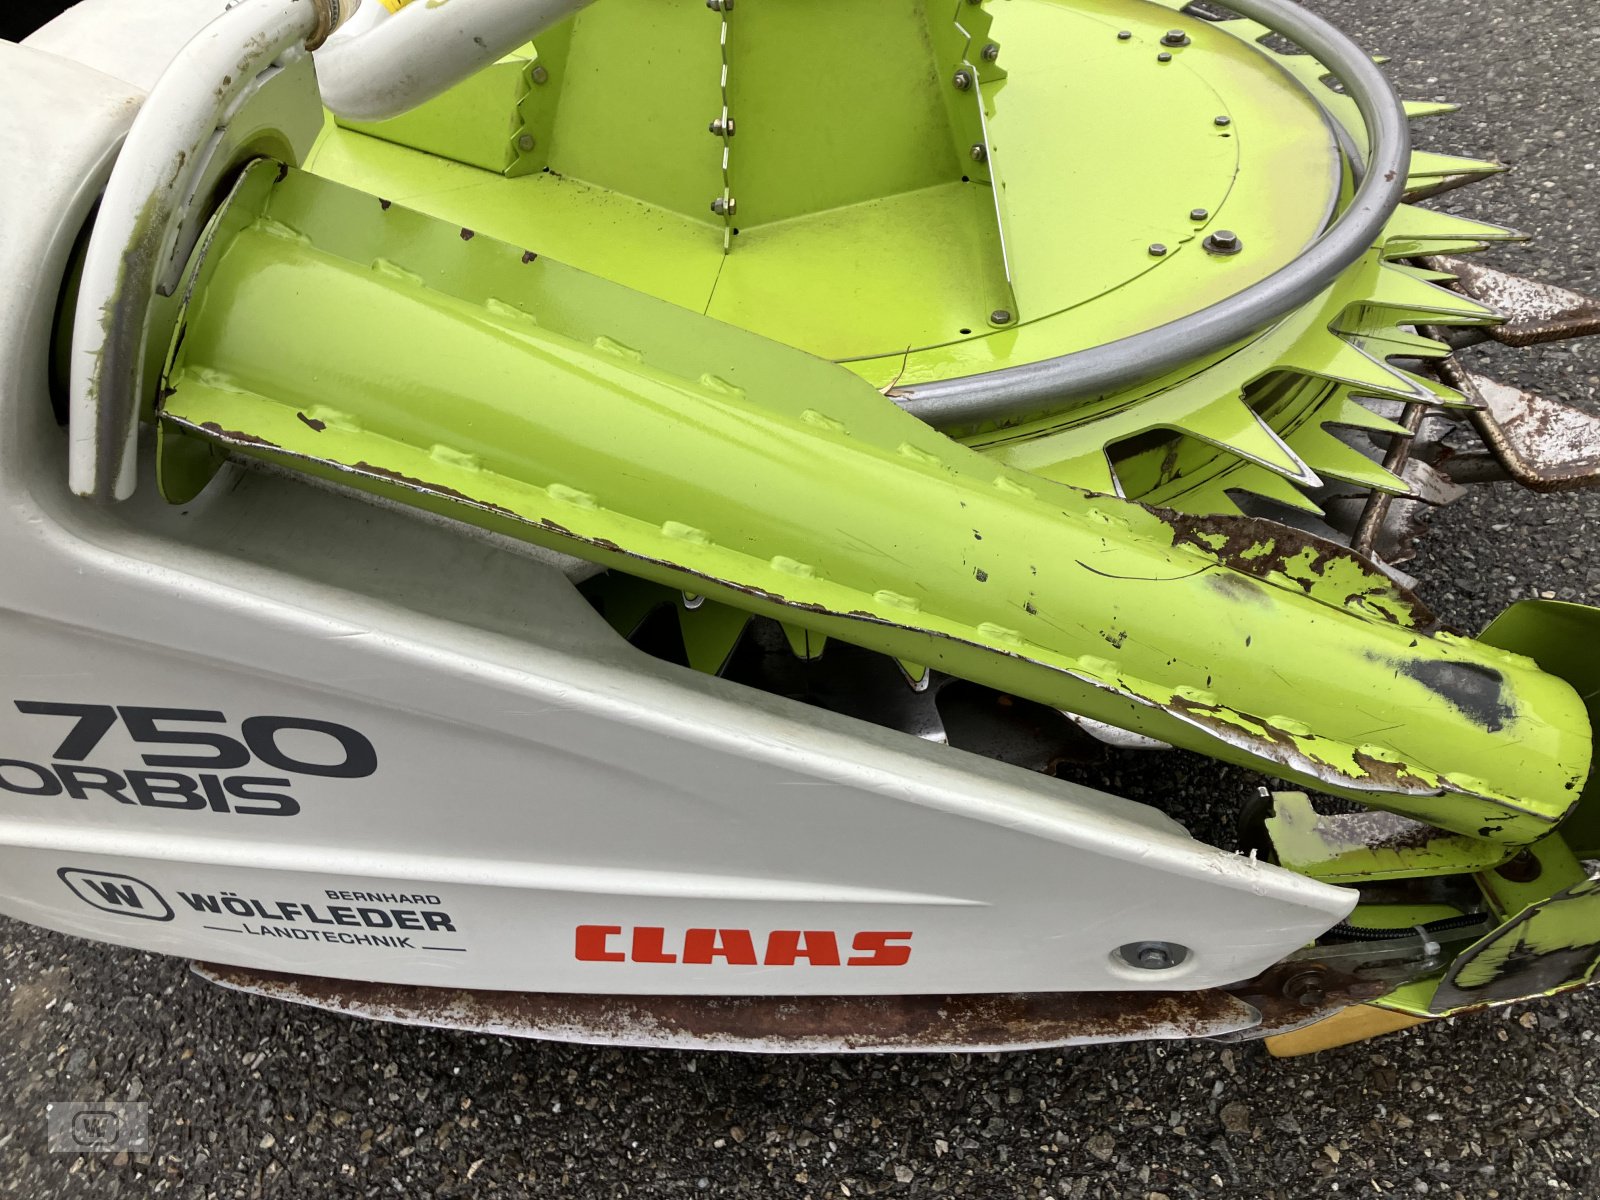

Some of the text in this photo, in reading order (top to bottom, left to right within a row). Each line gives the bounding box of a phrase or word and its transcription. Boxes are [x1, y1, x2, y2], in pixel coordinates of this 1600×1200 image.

[14, 700, 378, 778] 750
[0, 759, 301, 816] ORBIS
[82, 878, 144, 909] W
[177, 891, 457, 932] WÖLFLEDER
[325, 890, 441, 905] BERNHARD
[243, 924, 414, 949] LANDTECHNIK
[575, 925, 913, 966] CLAAS
